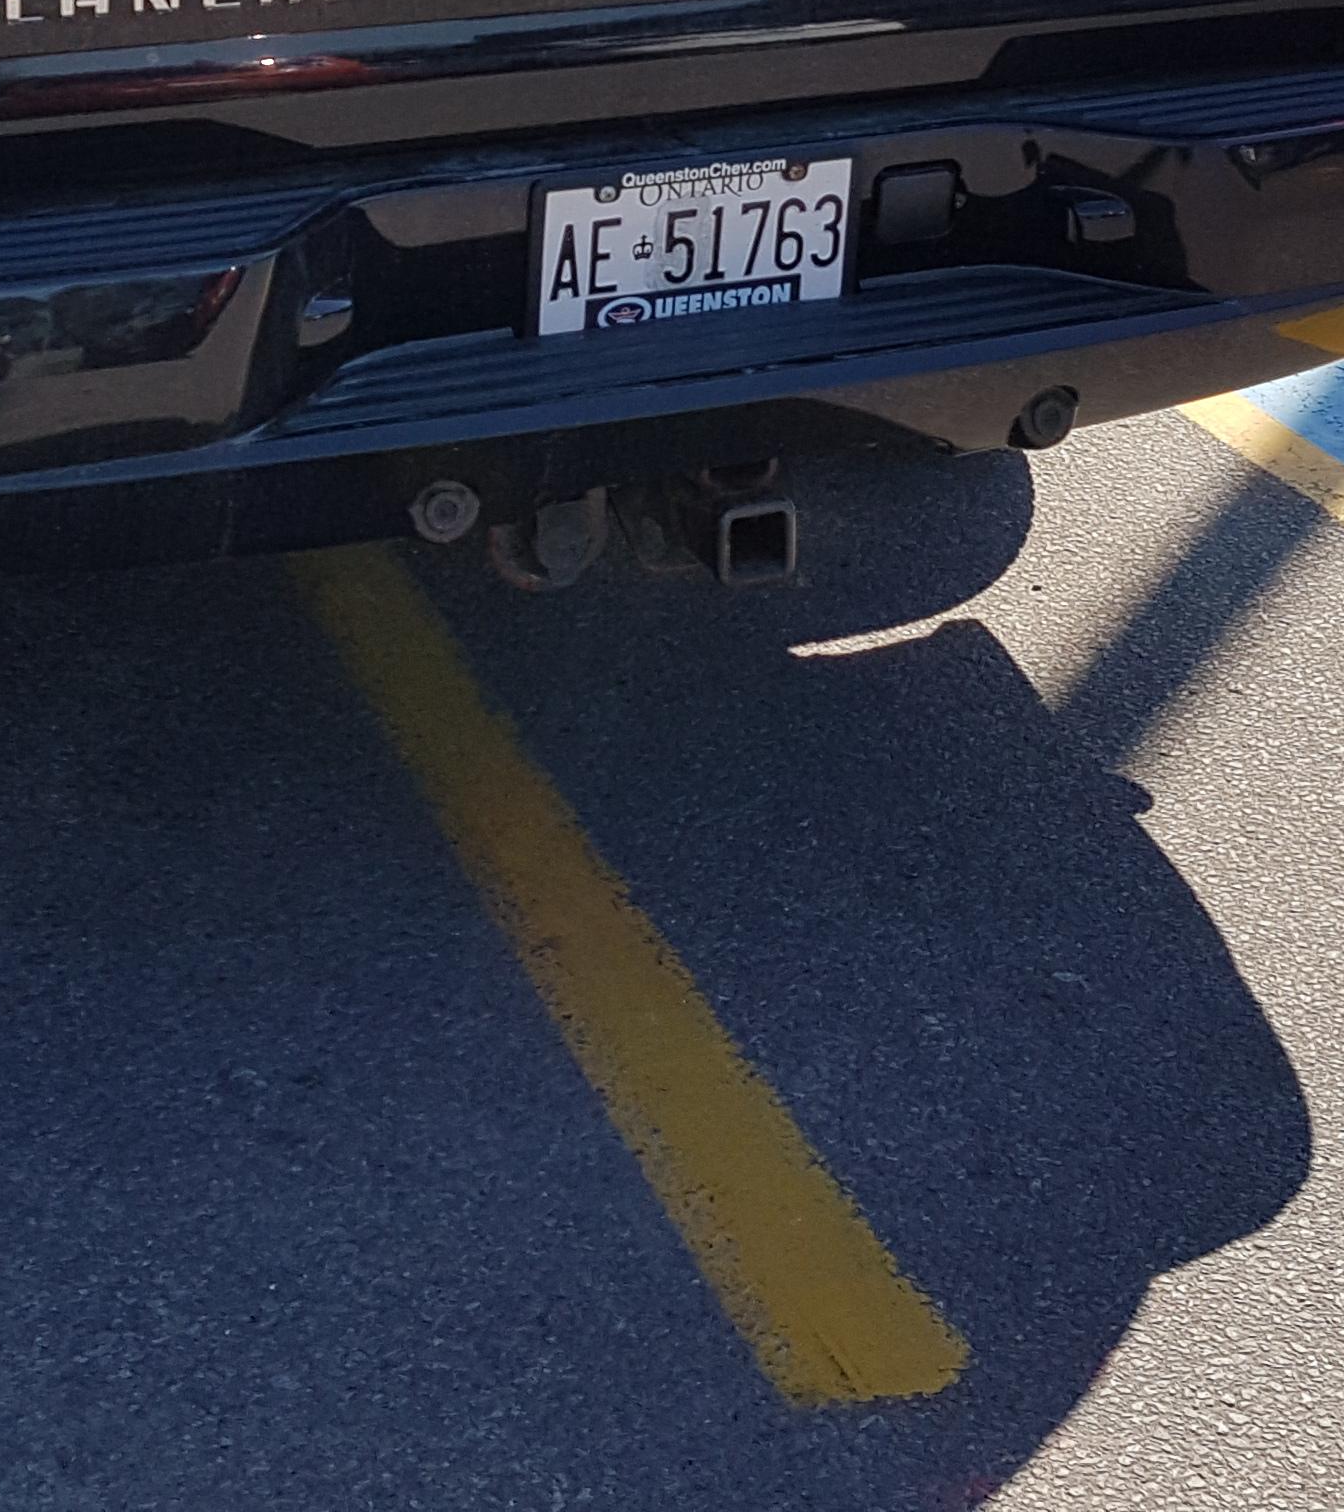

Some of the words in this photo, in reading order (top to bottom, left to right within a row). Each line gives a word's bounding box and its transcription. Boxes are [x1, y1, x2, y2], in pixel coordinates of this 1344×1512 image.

[621, 157, 787, 188] QueenstonChev.com
[639, 171, 764, 206] ONTARIO
[549, 217, 622, 301] AE
[662, 193, 844, 284] 51763
